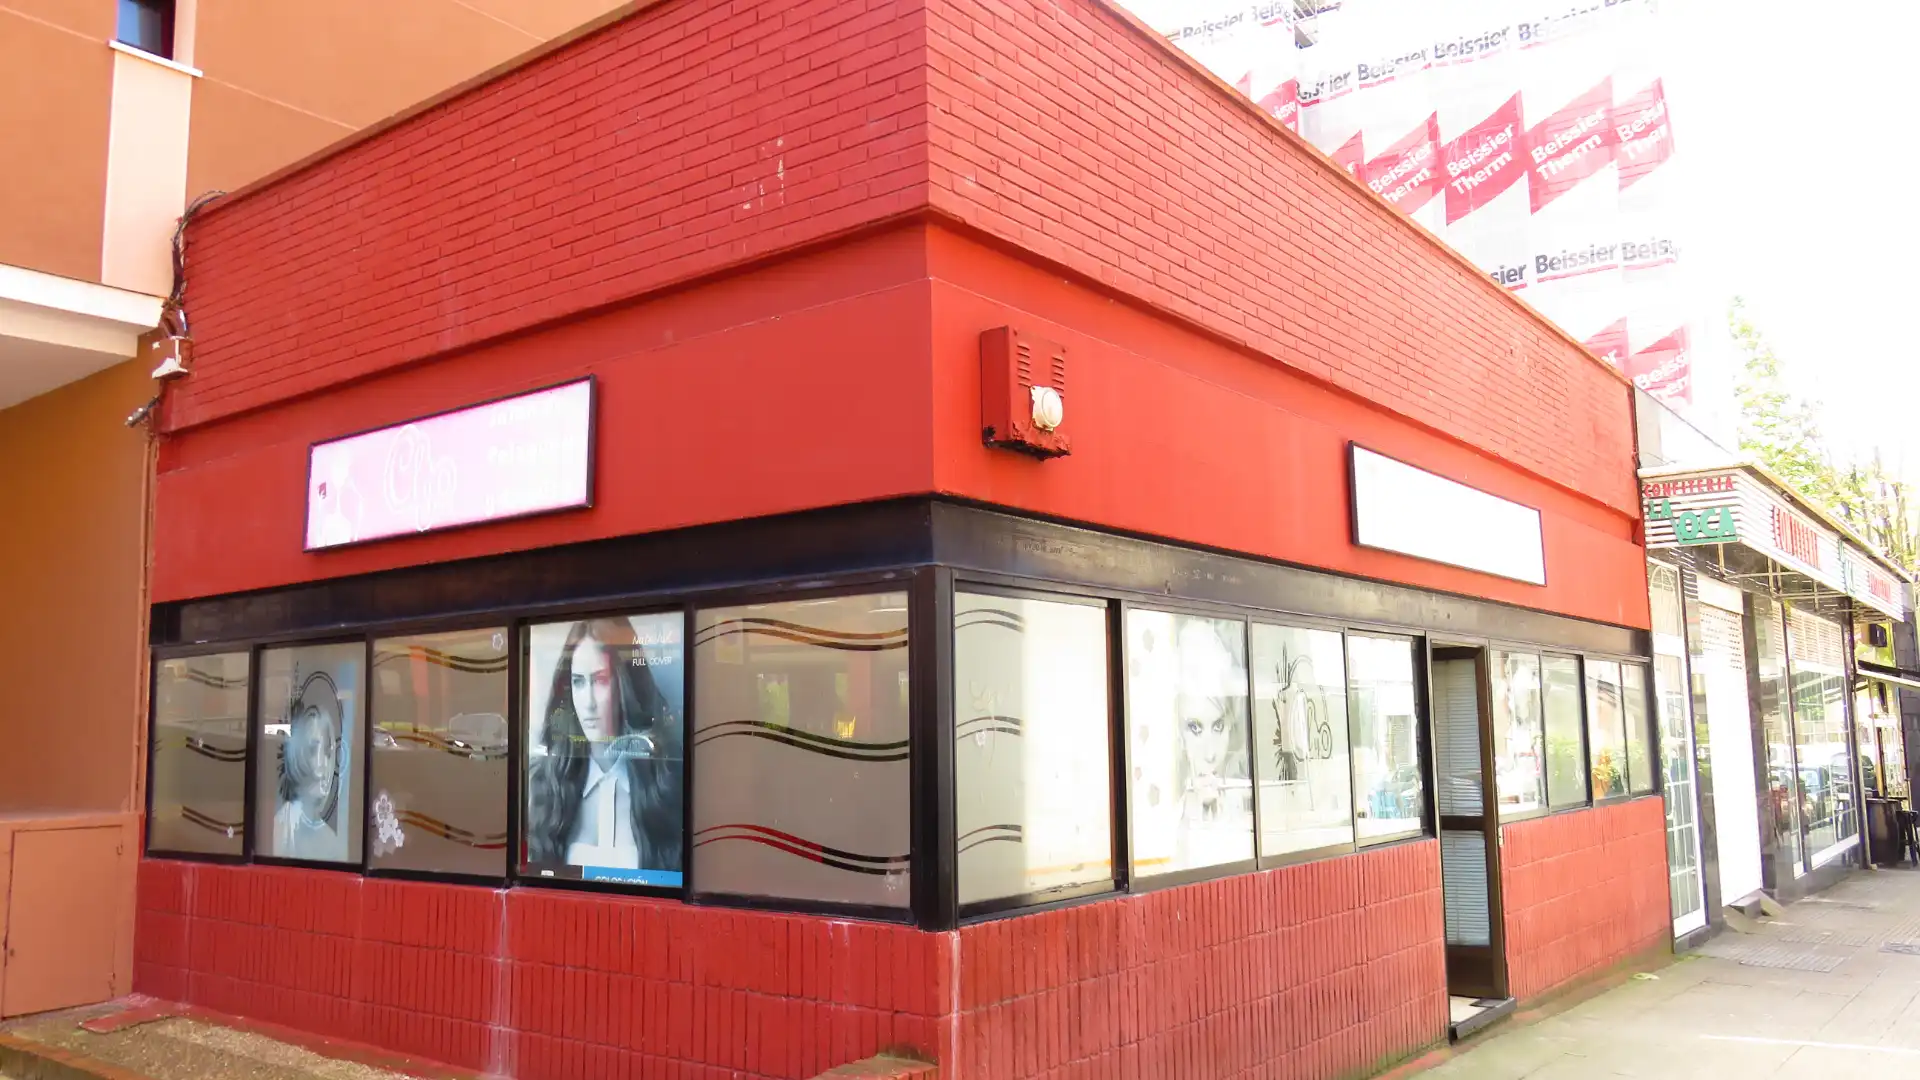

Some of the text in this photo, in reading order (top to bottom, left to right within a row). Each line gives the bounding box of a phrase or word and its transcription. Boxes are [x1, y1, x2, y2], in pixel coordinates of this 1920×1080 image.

[1367, 140, 1433, 194] Beissier
[1446, 123, 1515, 178] Beissier
[1536, 133, 1602, 181] Therm
[1381, 167, 1431, 204] herm
[1450, 151, 1513, 195] Therm
[1535, 243, 1618, 275] Beissier
[1643, 475, 1735, 498] CONFITERIA
[1648, 498, 1673, 519] LA
[1676, 504, 1737, 541] OCA
[632, 657, 647, 668] FULL
